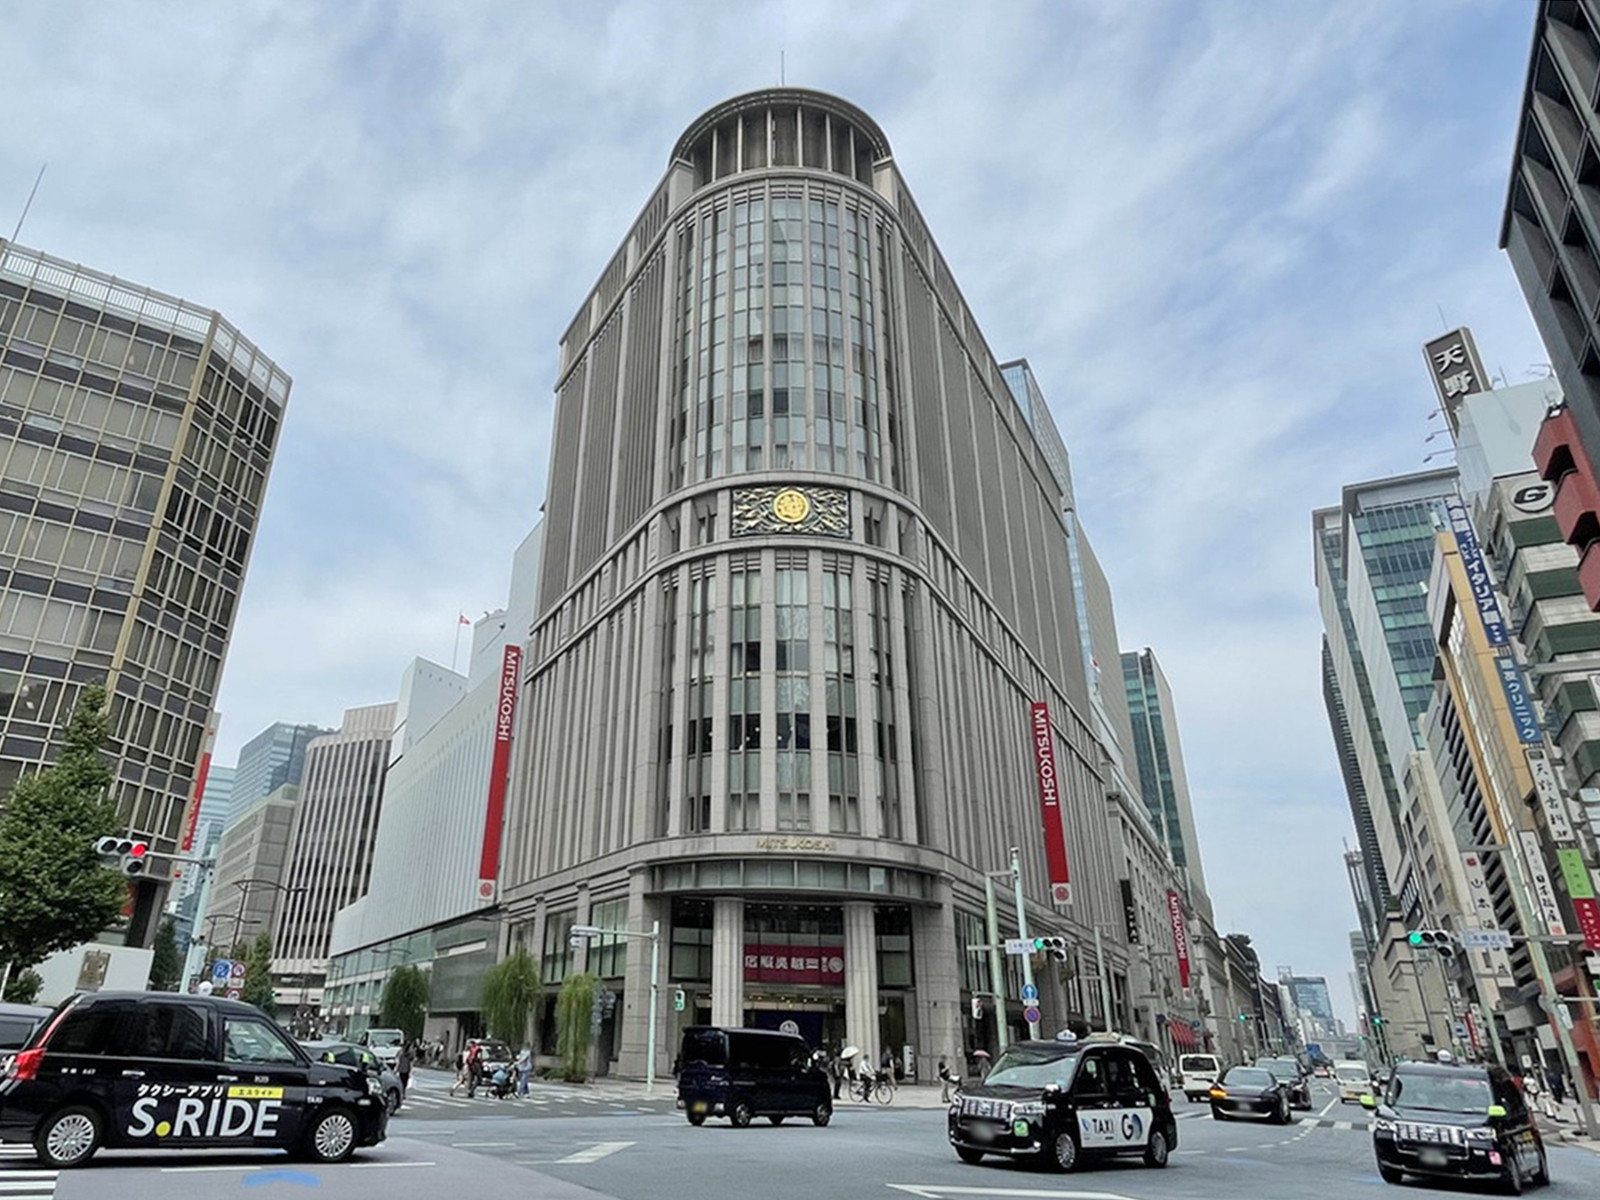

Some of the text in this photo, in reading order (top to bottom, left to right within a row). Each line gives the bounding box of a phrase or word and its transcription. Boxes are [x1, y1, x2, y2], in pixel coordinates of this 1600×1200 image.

[1433, 343, 1474, 397] 天野
[498, 649, 518, 741] MITSUKOSHI
[1500, 657, 1537, 739] クリニック
[1034, 708, 1057, 806] MITSUKOSHI
[1171, 896, 1187, 959] MITSUKOSHI
[127, 1098, 282, 1137] S.RIDE
[137, 1084, 224, 1097] タクシーアプリ
[1092, 1118, 1114, 1134] TAXI
